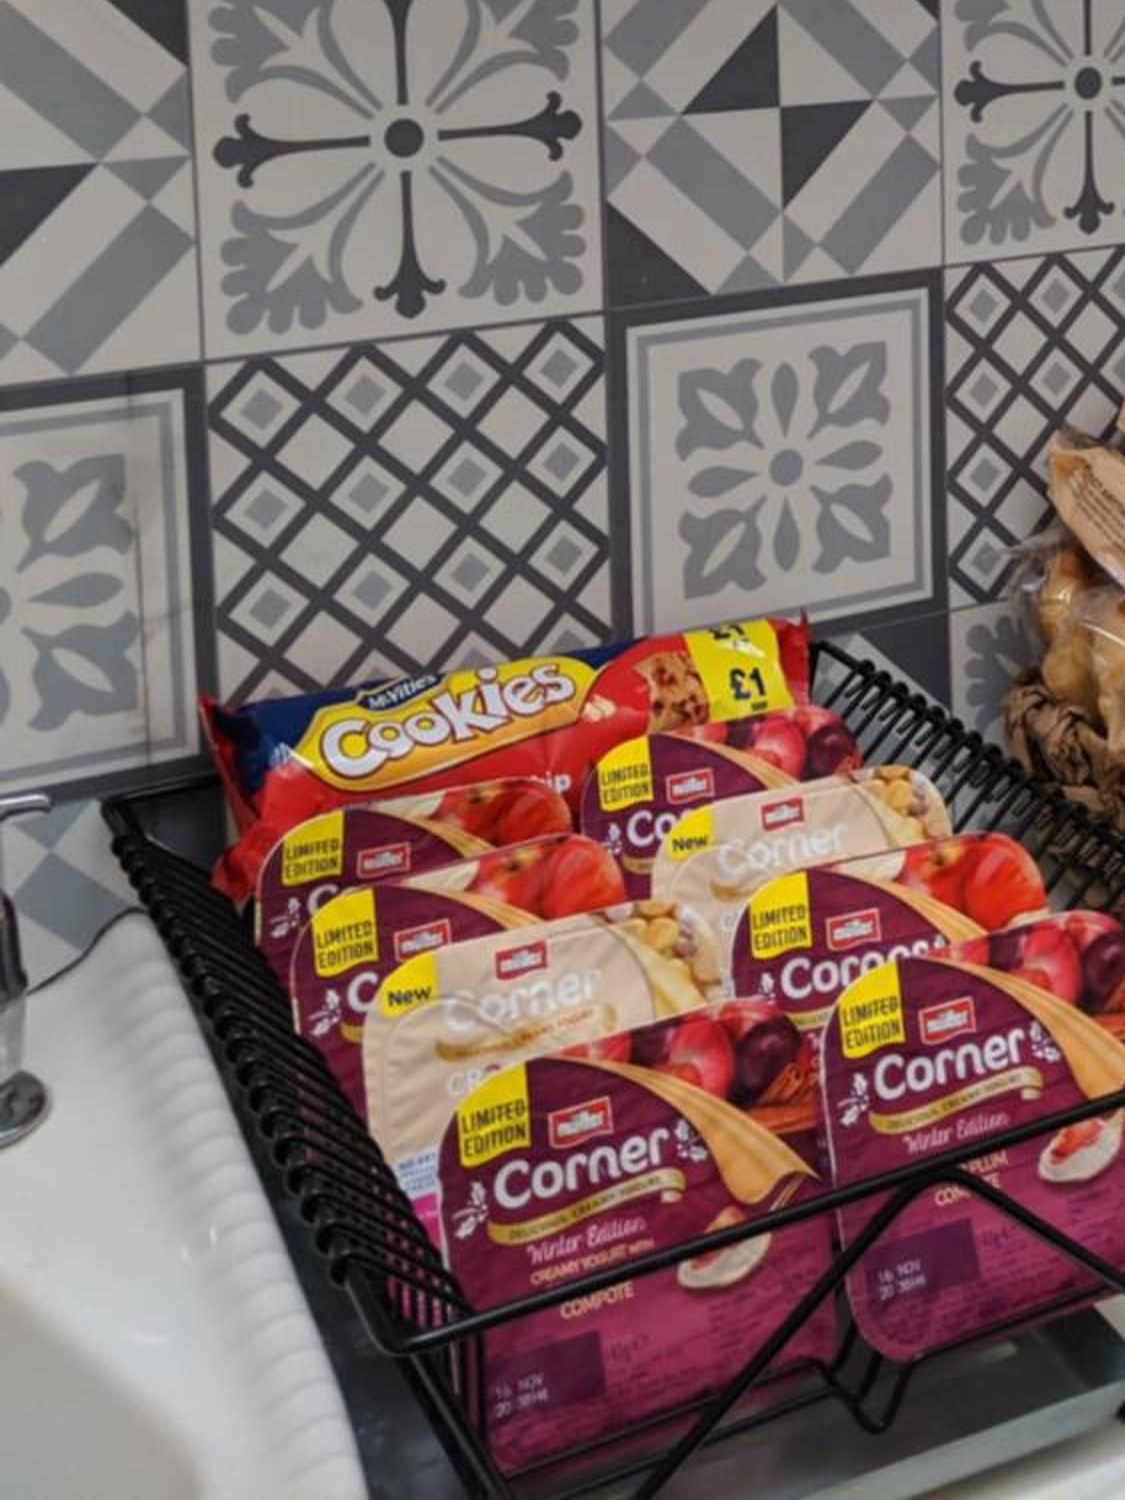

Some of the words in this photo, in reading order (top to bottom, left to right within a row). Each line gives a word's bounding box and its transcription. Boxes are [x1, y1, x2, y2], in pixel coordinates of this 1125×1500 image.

[730, 668, 766, 700] £1
[320, 664, 577, 779] Cookies
[672, 834, 709, 852] New
[752, 905, 806, 929] LIMITED
[316, 921, 373, 948] LIMITED
[755, 927, 807, 951] EDITION
[318, 944, 374, 969] EDITION
[388, 987, 432, 1007] New
[842, 996, 899, 1027] LIMITED
[845, 1020, 900, 1050] EDITION
[874, 1028, 1025, 1101] Corner
[461, 1099, 526, 1135] LIMITED
[464, 1124, 527, 1158] EDITION
[494, 1128, 670, 1210] Corner
